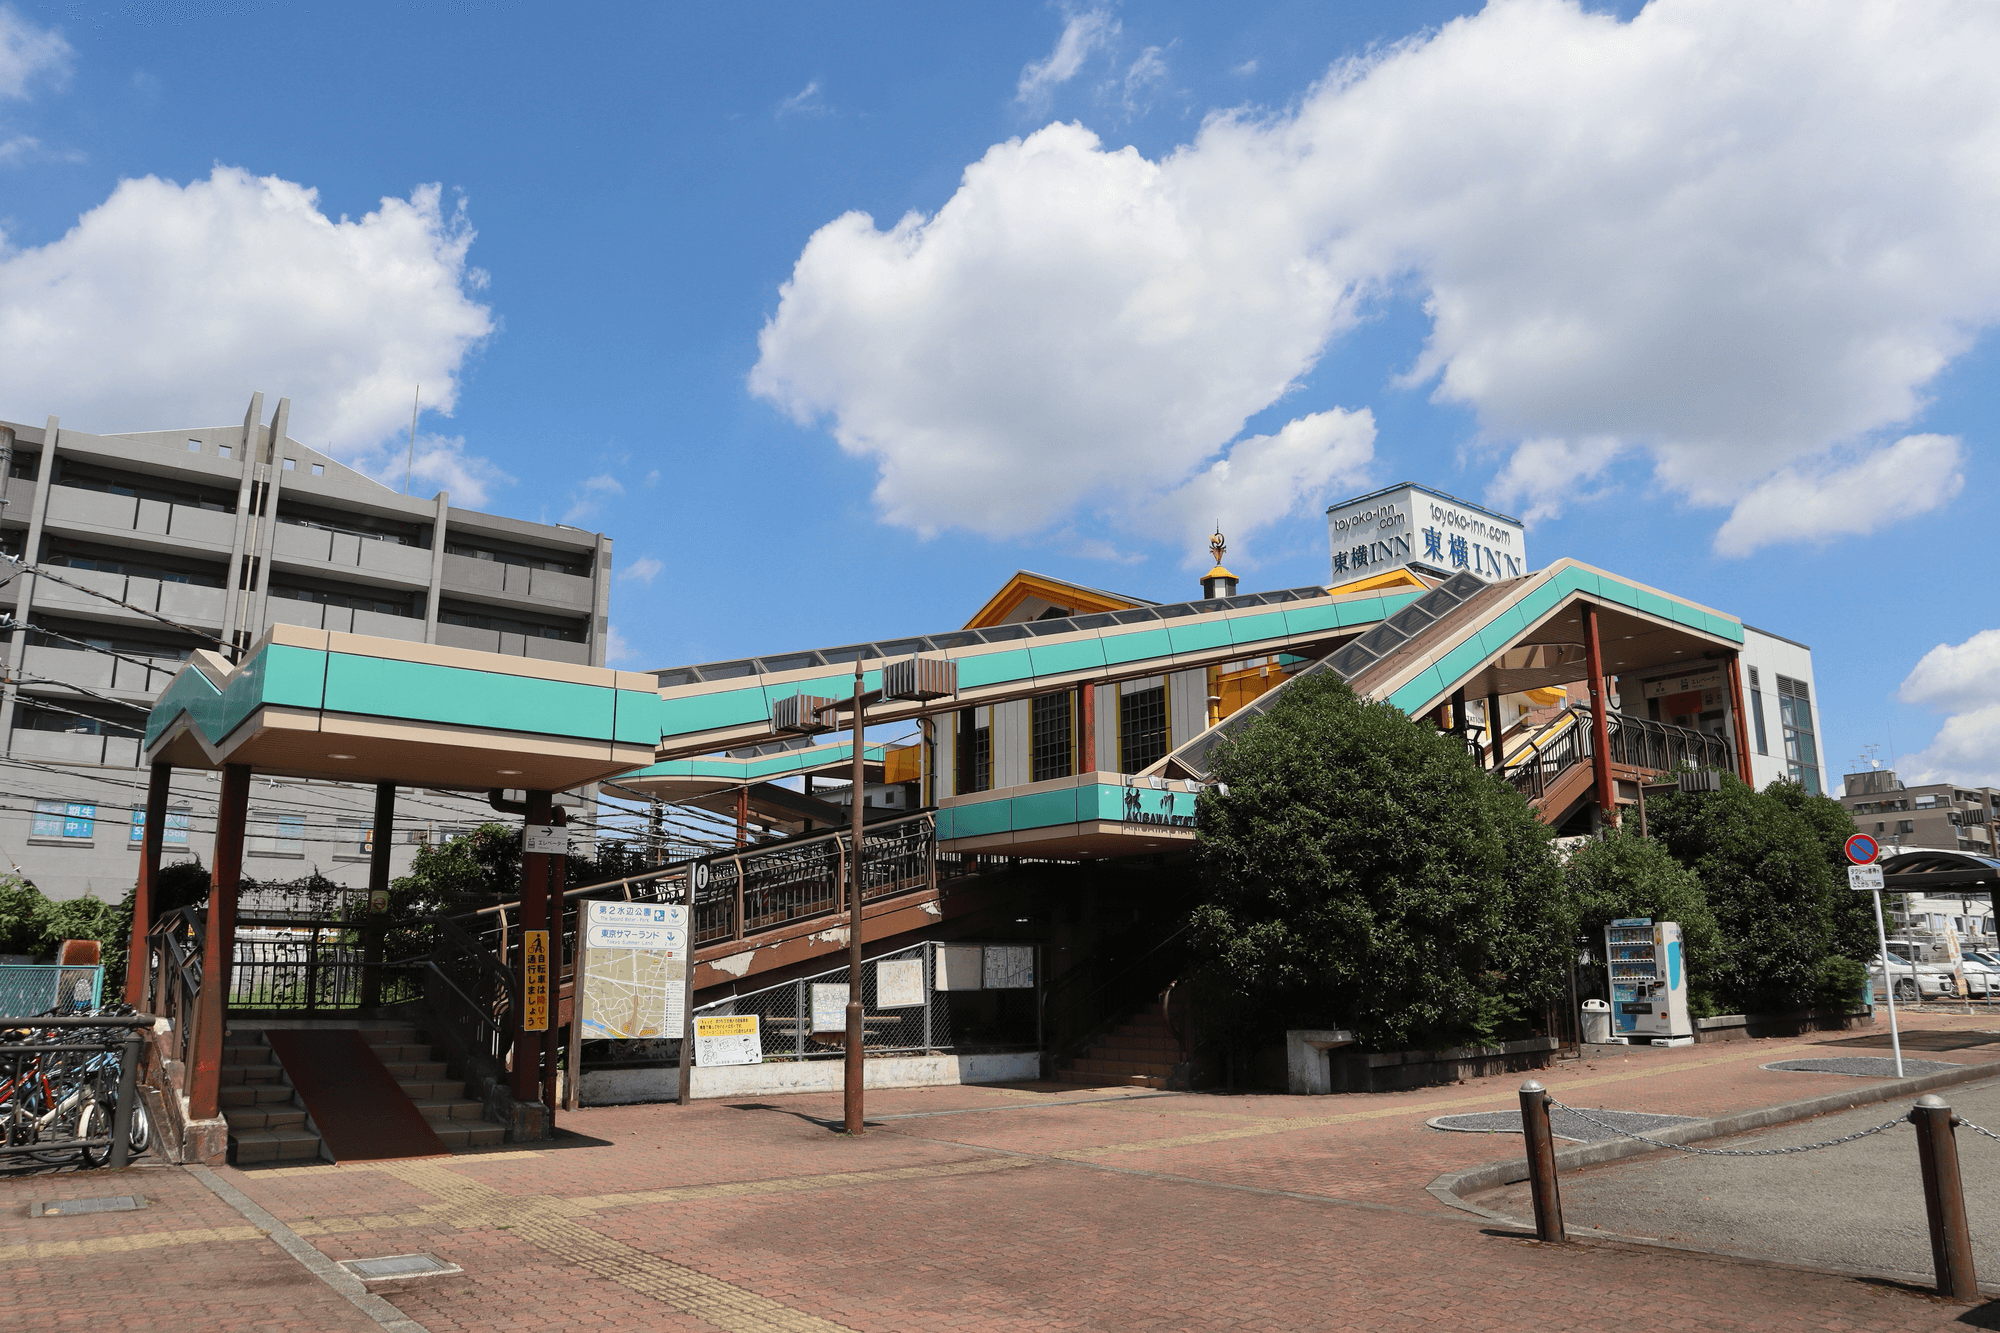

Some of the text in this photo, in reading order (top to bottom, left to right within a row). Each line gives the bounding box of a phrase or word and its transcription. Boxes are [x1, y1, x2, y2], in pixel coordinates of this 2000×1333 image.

[1334, 502, 1396, 531] toyoko-inn
[1377, 511, 1406, 531] .com
[1429, 502, 1511, 545] toyoko-inn.com
[1332, 532, 1412, 575] 東横INN
[1421, 525, 1521, 580] 東横INN
[538, 839, 566, 847] エレベーター
[599, 905, 651, 917] 第2水辺公園
[601, 929, 659, 939] 東京サマーランド
[526, 954, 537, 1027] 通行しましょう
[536, 953, 546, 1026] 自転車は降りて
